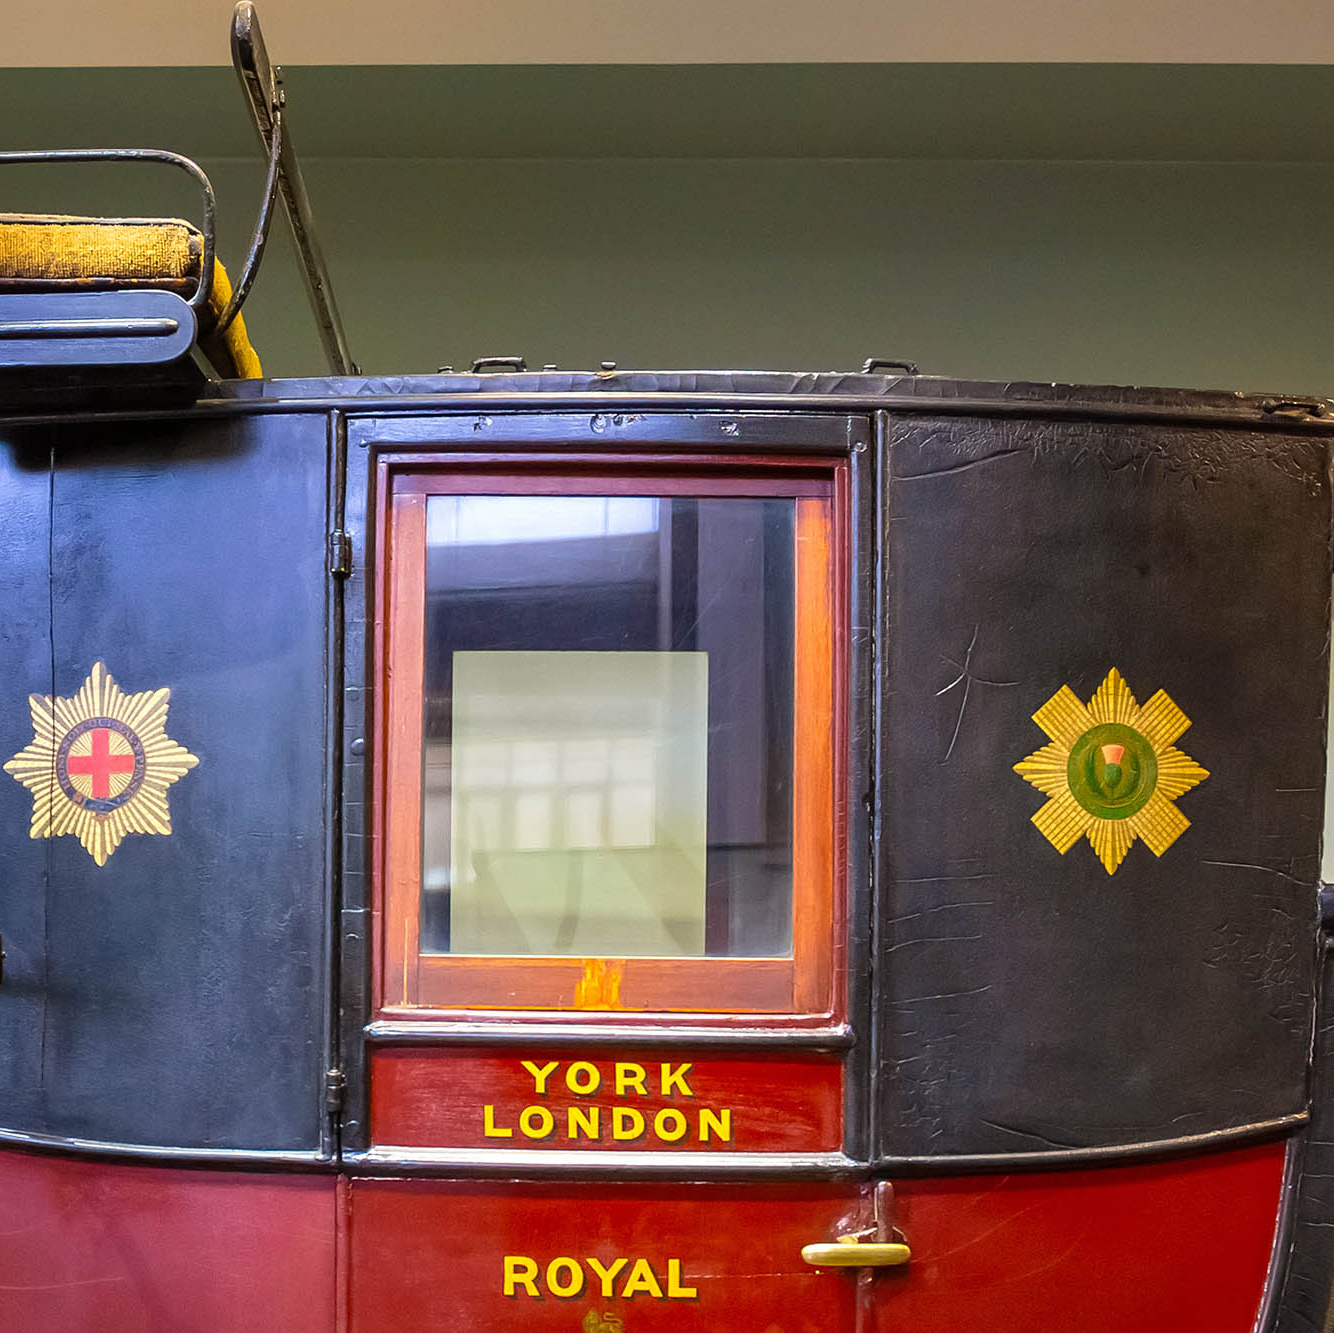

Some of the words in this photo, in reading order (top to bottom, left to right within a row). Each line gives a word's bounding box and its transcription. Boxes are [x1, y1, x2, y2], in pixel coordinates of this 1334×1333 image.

[520, 1060, 694, 1097] YORK
[482, 1104, 732, 1142] LONDON
[502, 1255, 699, 1299] ROYAL
